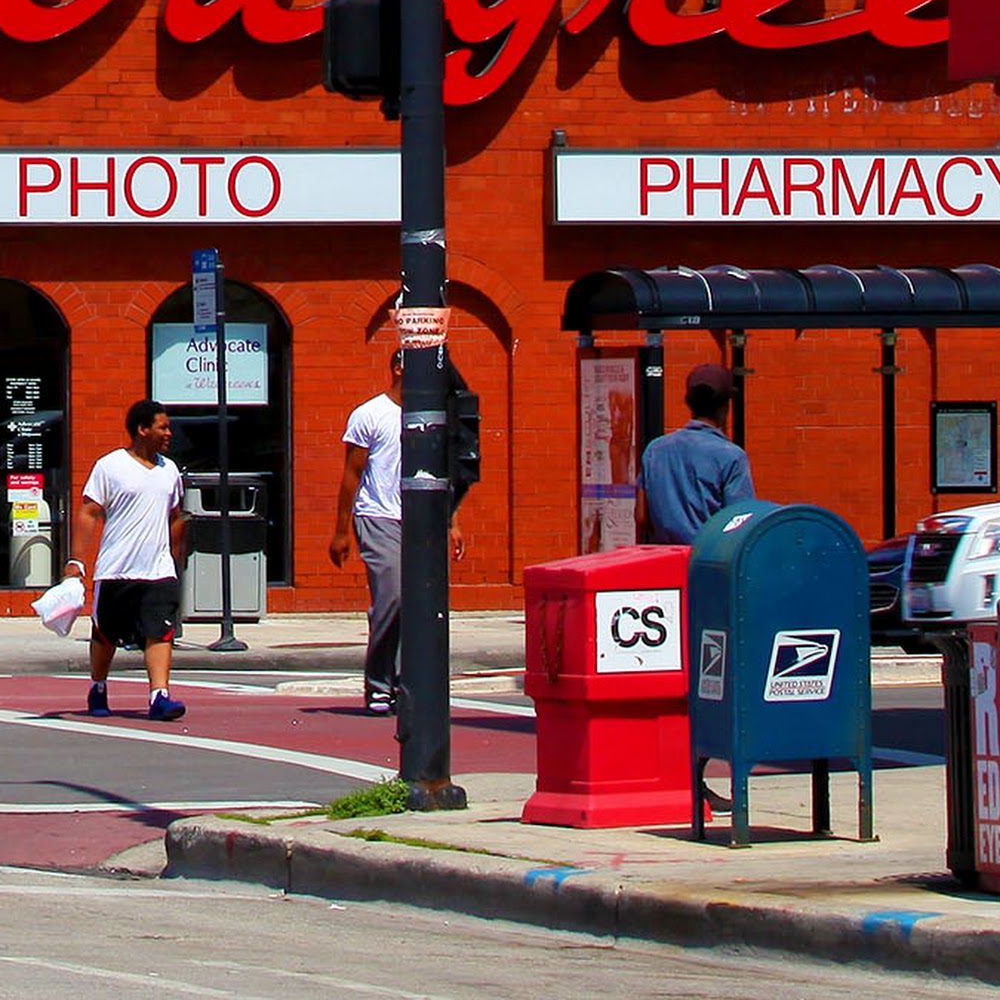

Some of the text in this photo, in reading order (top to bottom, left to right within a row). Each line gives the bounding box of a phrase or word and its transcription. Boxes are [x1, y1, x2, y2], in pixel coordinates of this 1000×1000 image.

[17, 155, 282, 218] PHOTO
[405, 317, 444, 325] PARKING
[186, 337, 261, 353] Advcate
[611, 606, 667, 648] CS
